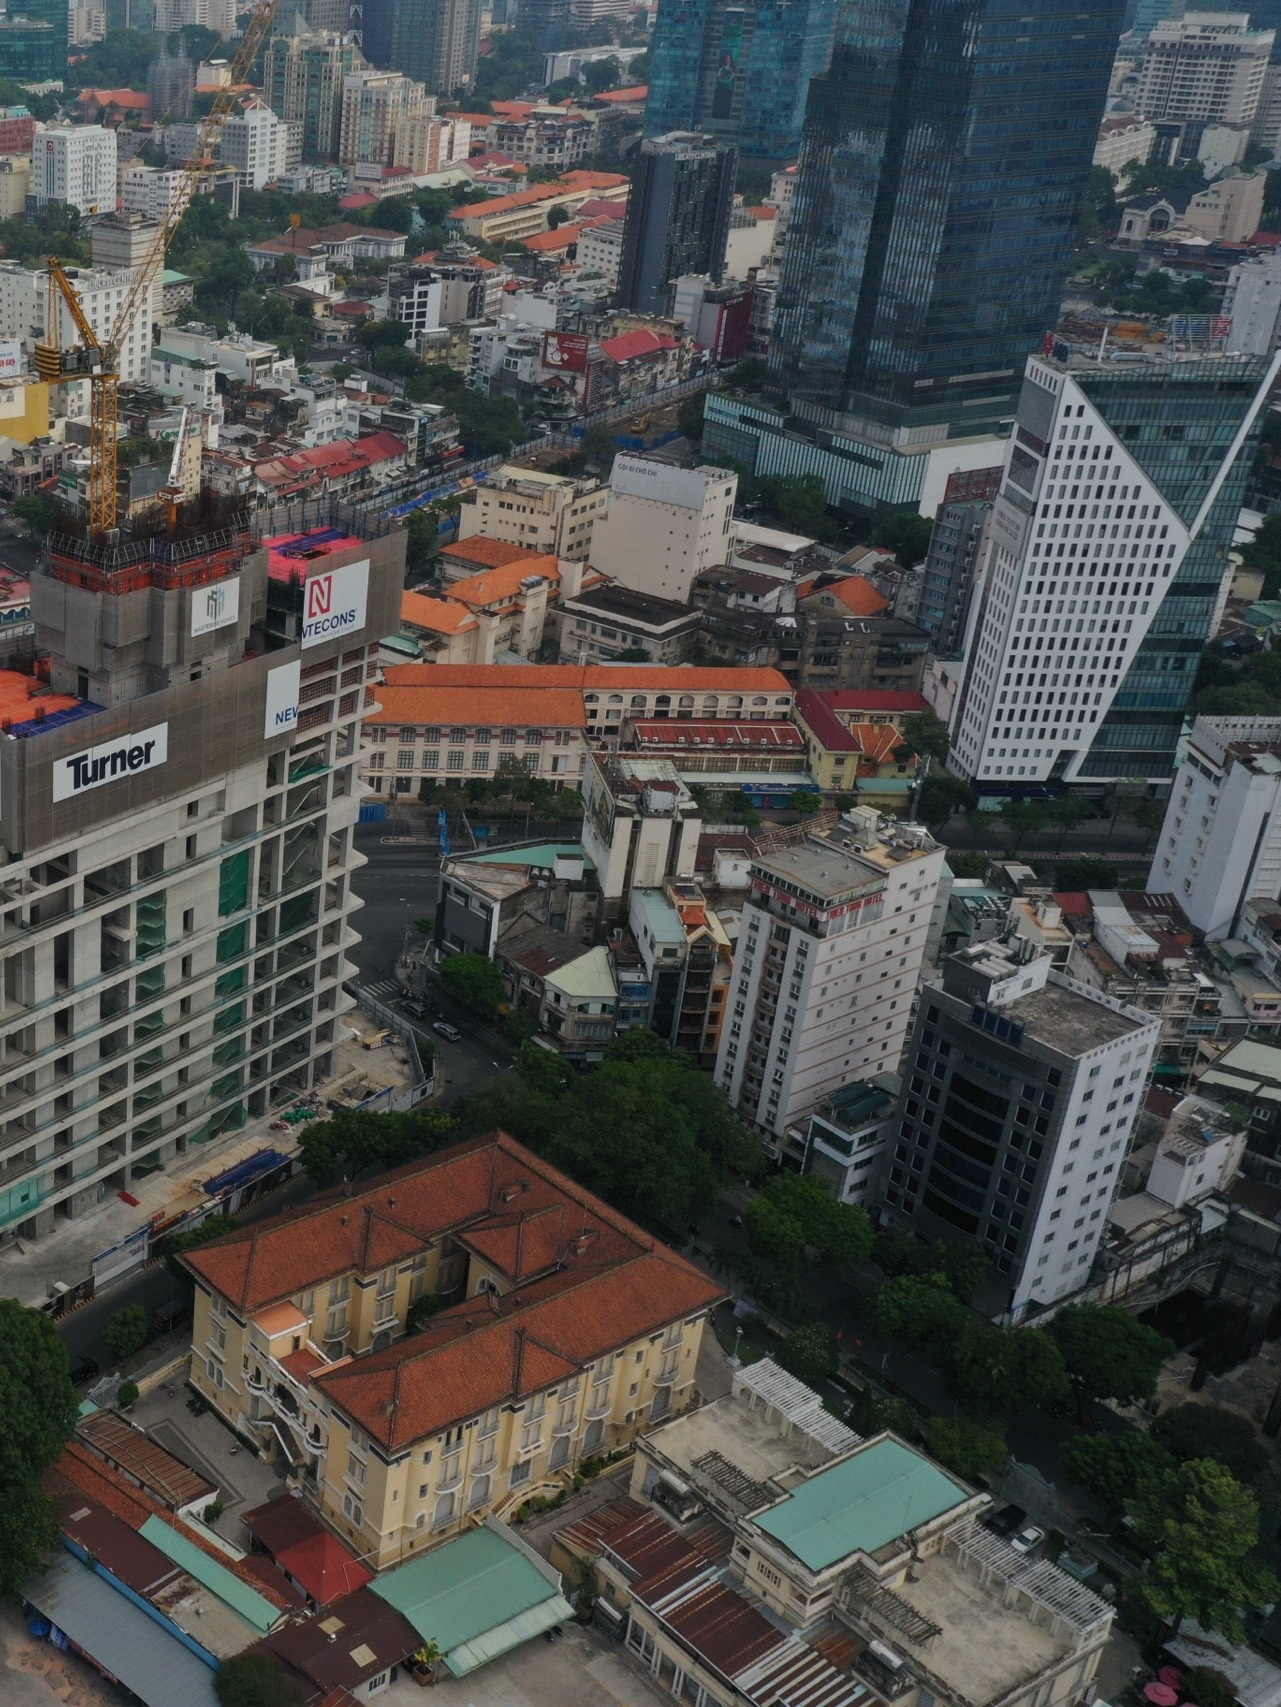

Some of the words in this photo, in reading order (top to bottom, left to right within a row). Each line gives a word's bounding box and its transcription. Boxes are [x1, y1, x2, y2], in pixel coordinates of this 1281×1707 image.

[66, 739, 156, 790] Turner
[794, 899, 818, 919] HOTEL
[863, 893, 884, 907] HOTEL
